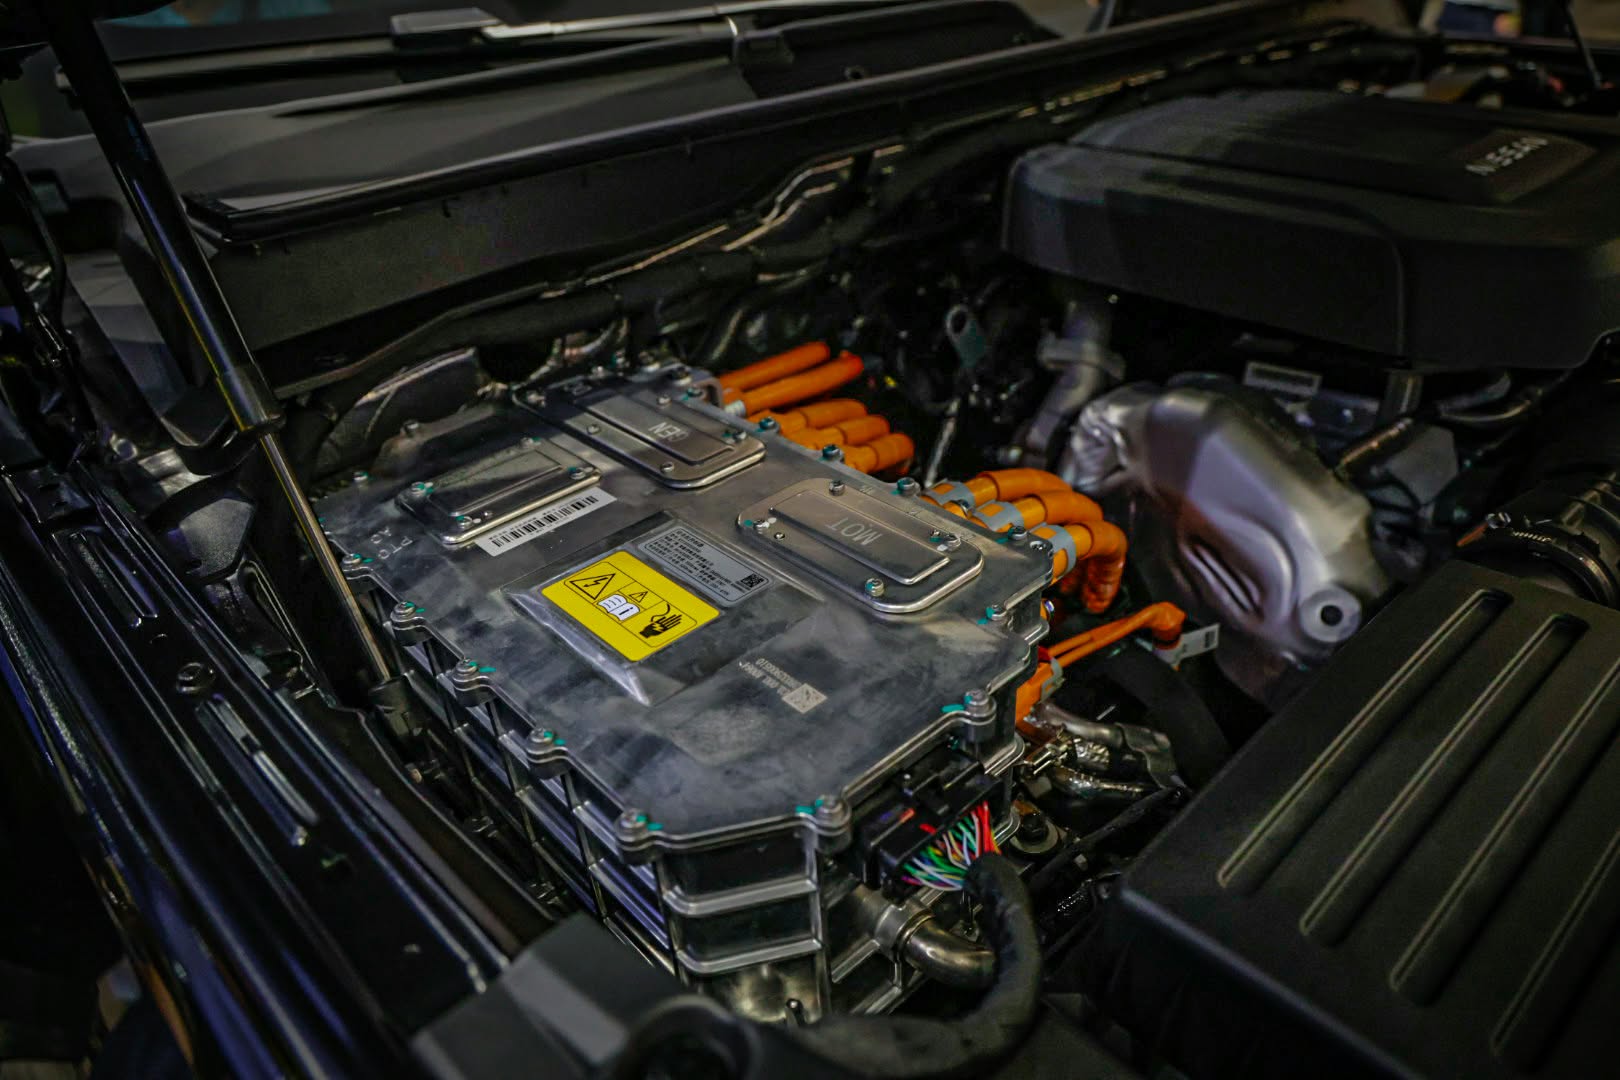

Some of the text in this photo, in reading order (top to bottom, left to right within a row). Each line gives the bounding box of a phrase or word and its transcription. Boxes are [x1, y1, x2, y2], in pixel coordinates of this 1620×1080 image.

[1464, 137, 1548, 176] NISSAN
[648, 422, 689, 441] GEN
[825, 517, 882, 546] MOT
[378, 536, 413, 559] PTC
